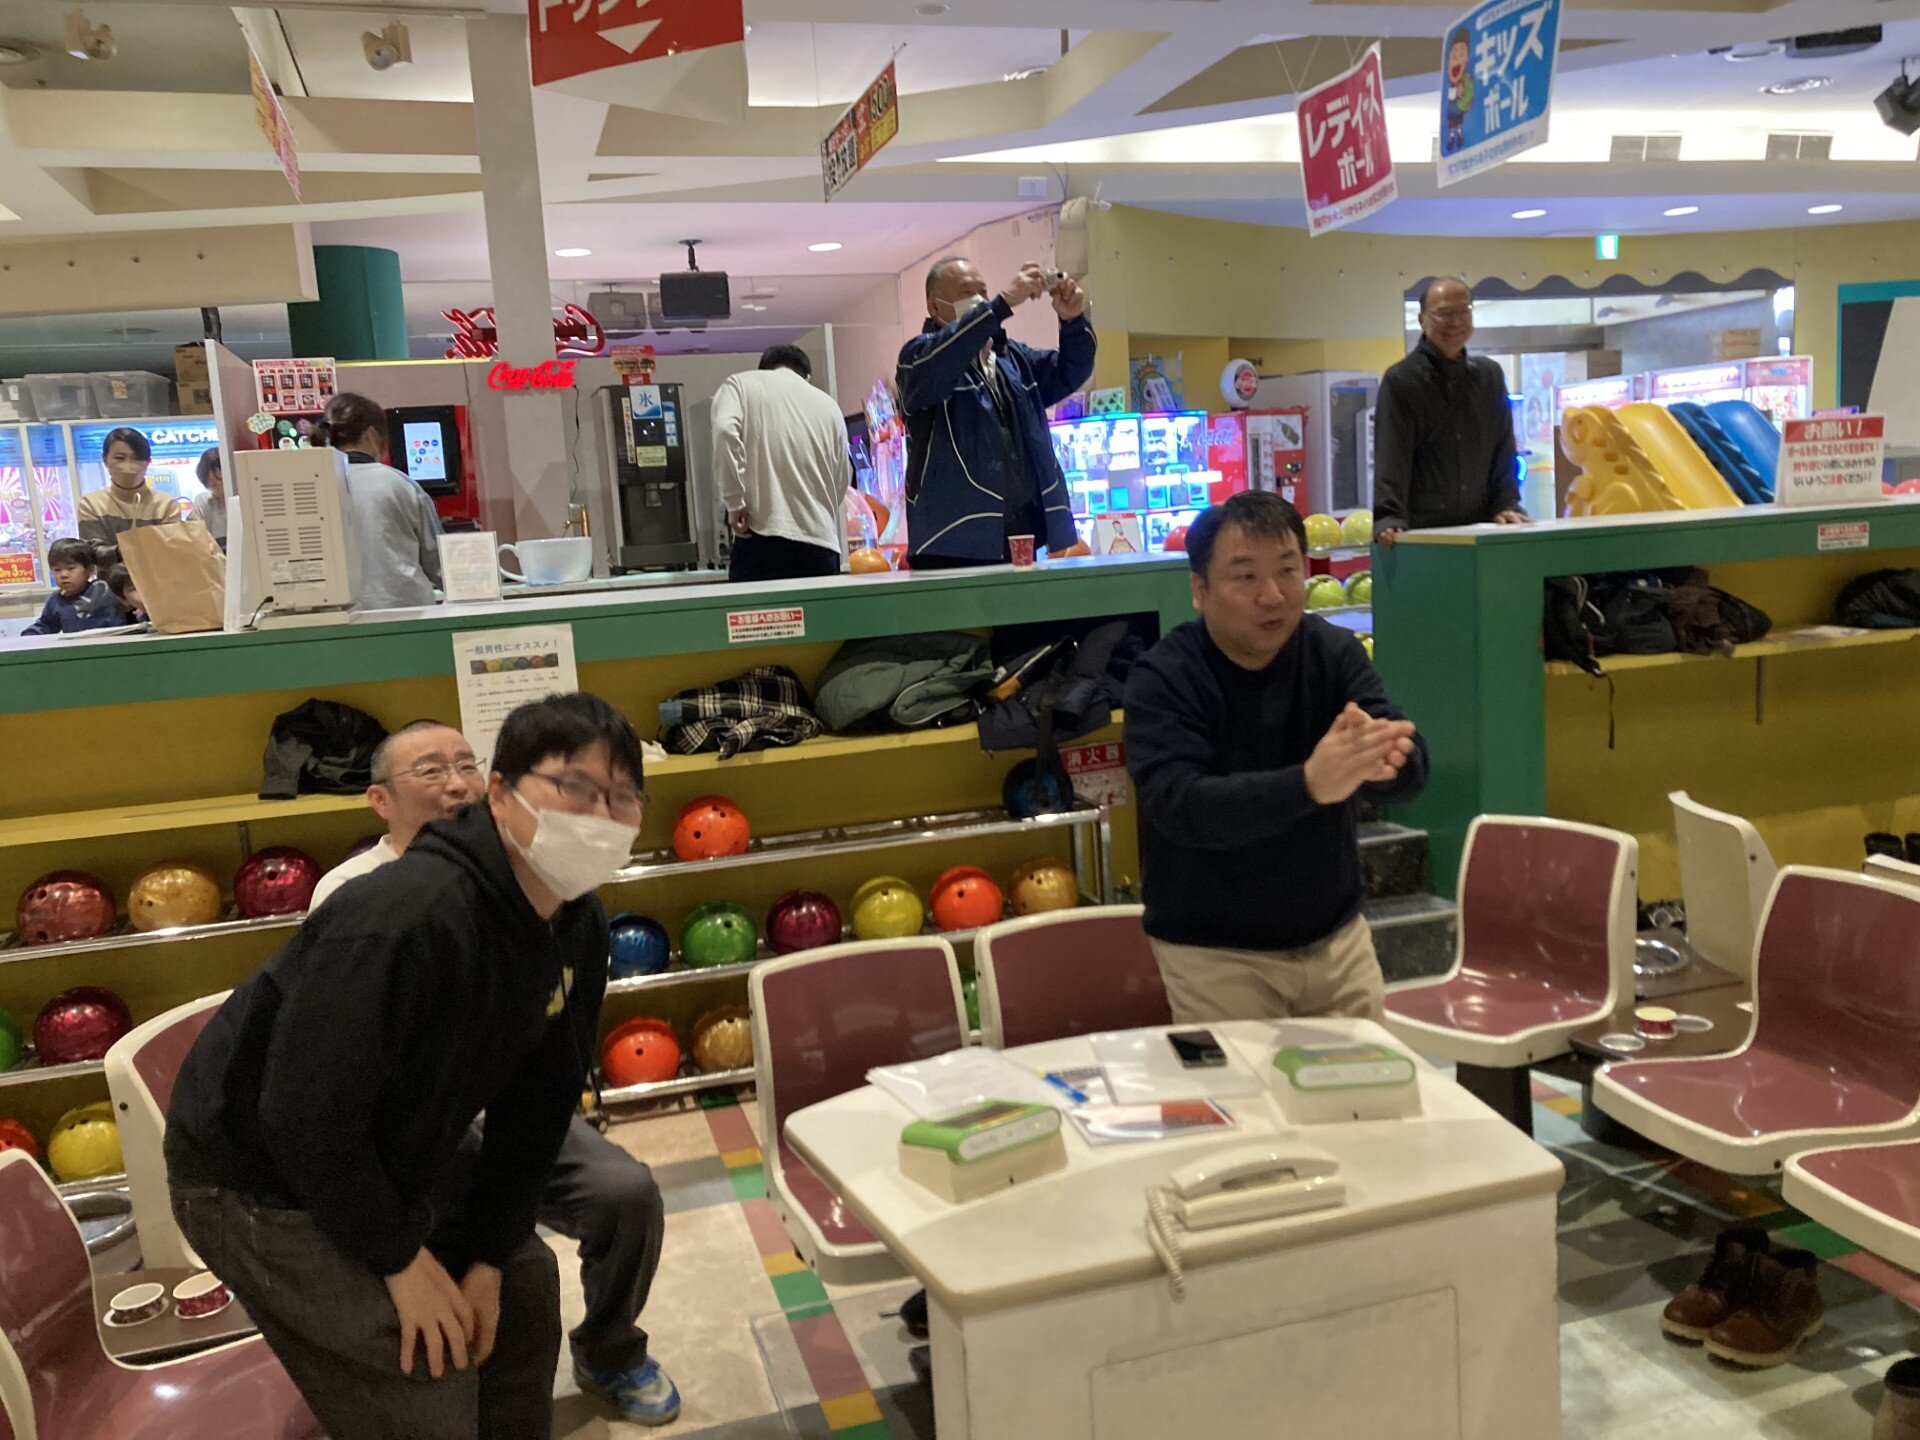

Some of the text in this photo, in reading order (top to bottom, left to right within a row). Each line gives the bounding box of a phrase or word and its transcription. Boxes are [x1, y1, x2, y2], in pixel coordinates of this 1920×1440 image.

[1475, 0, 1554, 87] キッズ
[1484, 75, 1529, 135] ボール
[487, 359, 580, 391] Coca-Cola
[640, 392, 653, 407] 氷
[465, 639, 558, 655] 一般男性にオススメ！
[1067, 744, 1120, 768] 消火器
